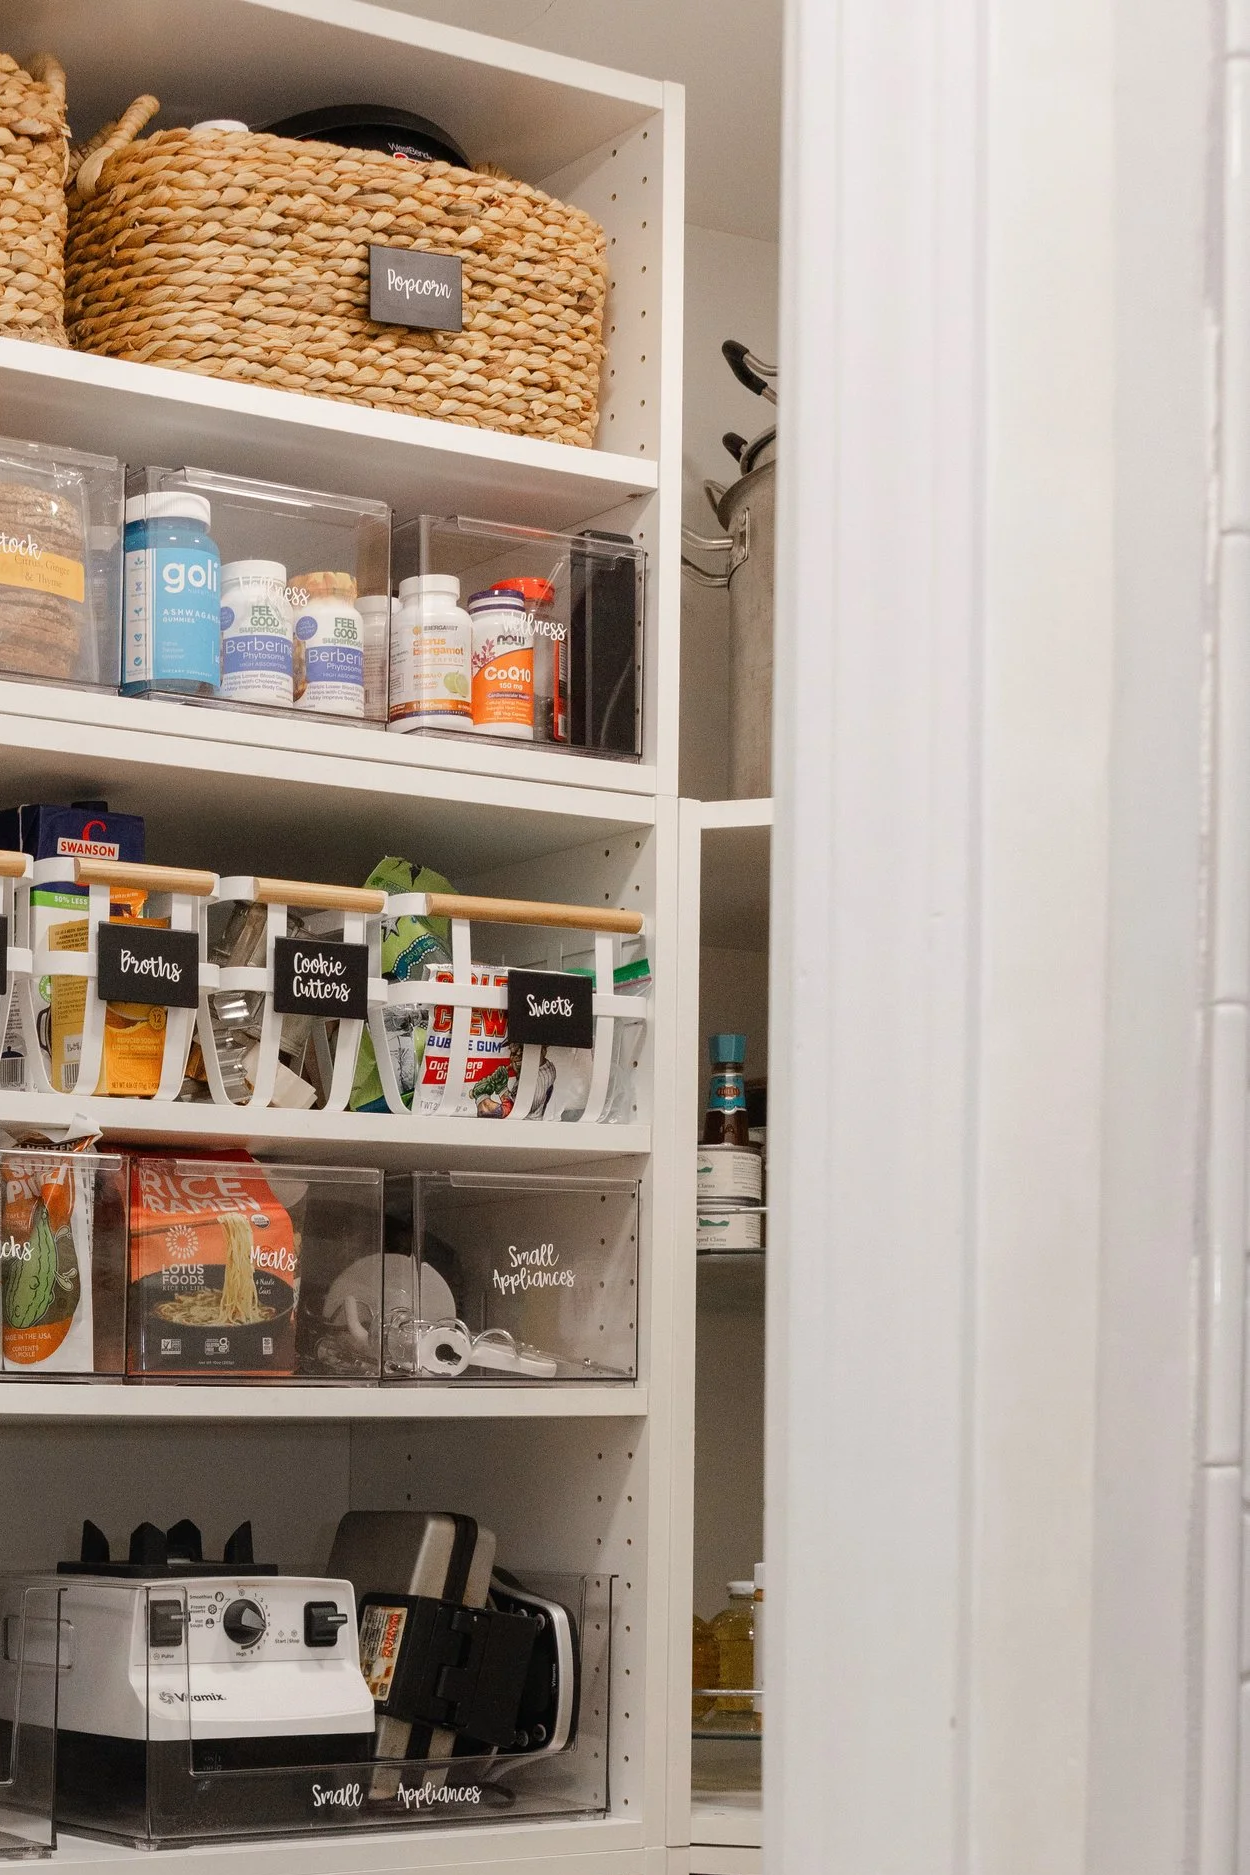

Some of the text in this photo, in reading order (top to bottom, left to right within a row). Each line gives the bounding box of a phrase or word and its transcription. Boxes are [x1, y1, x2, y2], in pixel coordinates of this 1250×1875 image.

[387, 268, 452, 300] Popcorn
[162, 558, 219, 593] goli
[239, 576, 310, 607] Wellness
[250, 616, 279, 628] GOOD
[334, 628, 358, 640] GOOD
[335, 617, 357, 630] FEEL
[502, 612, 567, 641] Wellness
[484, 666, 531, 683] CoQ10
[60, 841, 117, 857] SWANSON
[71, 897, 88, 905] LESS
[120, 948, 182, 983] Broths
[293, 951, 346, 977] Cookie
[292, 976, 351, 1003] Cutters
[527, 993, 574, 1018] Sweets
[433, 1004, 508, 1038] CEW
[477, 1040, 502, 1053] GUM
[140, 1170, 249, 1199] RICE
[147, 1194, 262, 1215] RAMEN
[249, 1245, 297, 1272] Meals
[508, 1243, 560, 1268] Small
[162, 1264, 204, 1275] LOTUS
[162, 1275, 205, 1285] FOODS
[493, 1267, 577, 1295] Appliances
[25, 1333, 52, 1341] THE USA
[312, 1781, 482, 1808] Small Appliances
